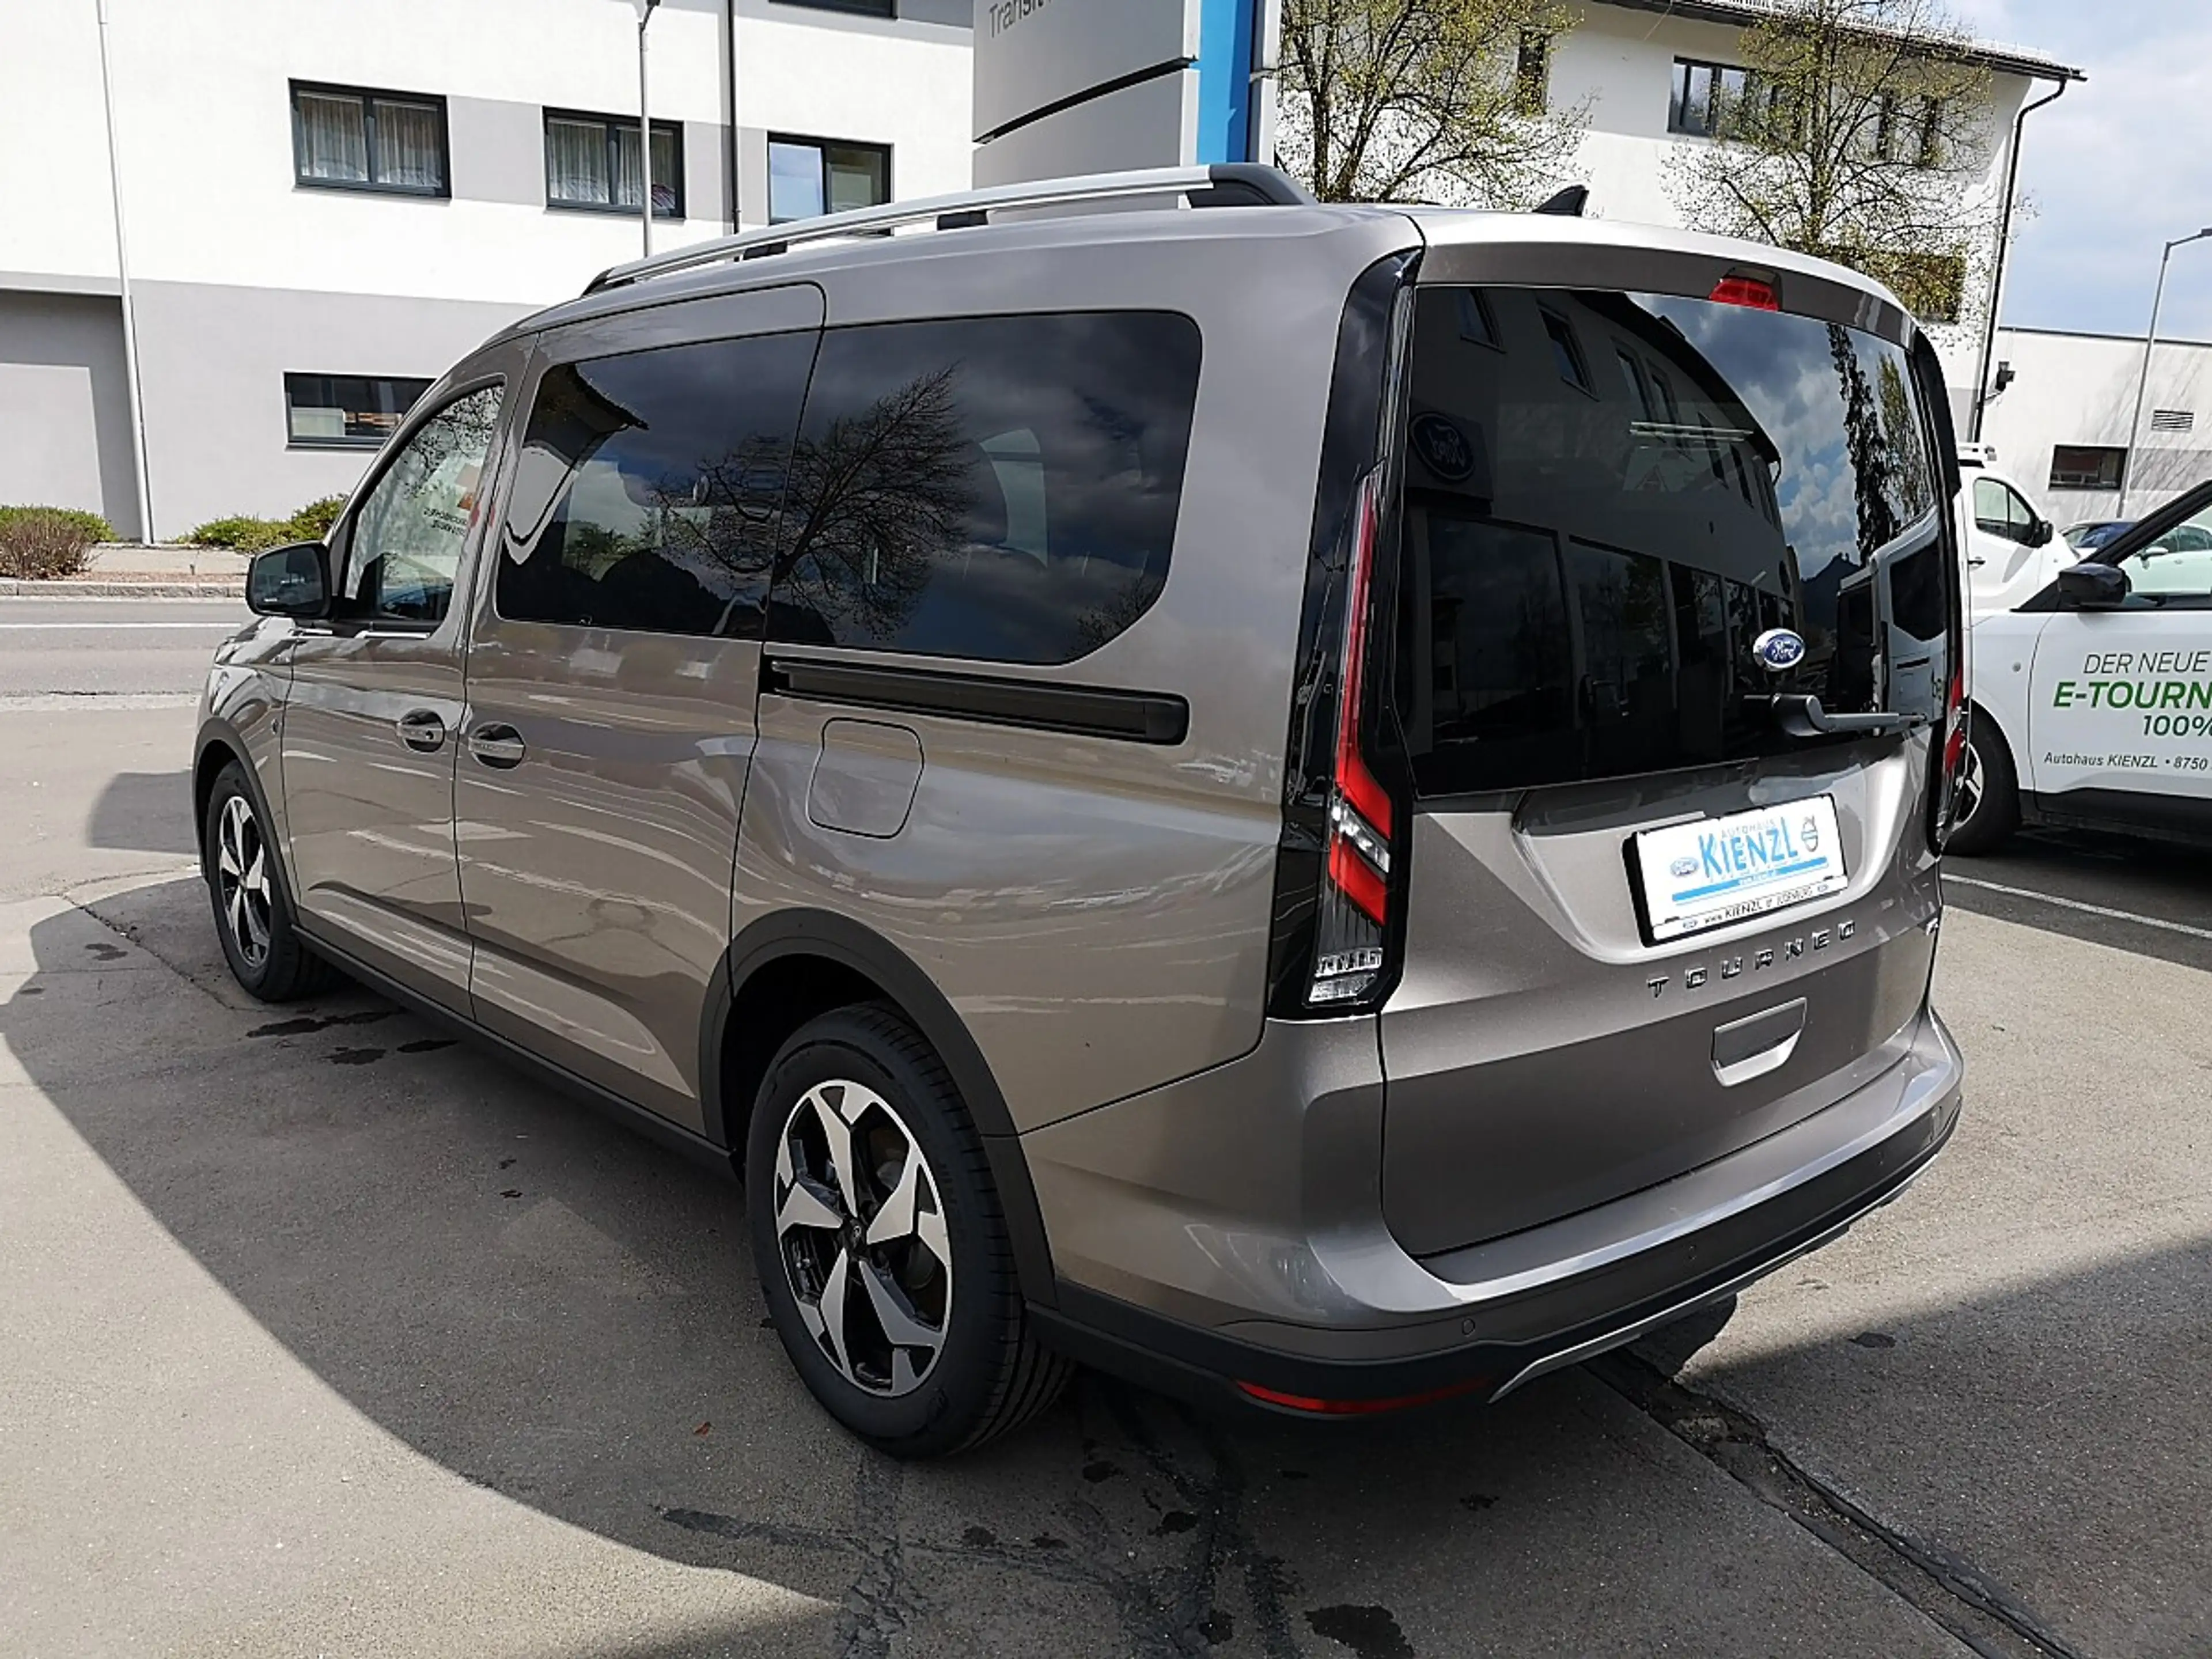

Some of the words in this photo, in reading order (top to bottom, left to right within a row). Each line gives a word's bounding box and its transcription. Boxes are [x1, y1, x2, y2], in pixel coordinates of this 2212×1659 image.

[989, 0, 1044, 38] Trans
[2084, 654, 2134, 674] DER
[2138, 651, 2211, 673] NEUE
[2054, 681, 2212, 710] E-TOURN
[2044, 752, 2103, 766] Autohaus
[2107, 755, 2158, 768] KIENZL
[2173, 756, 2209, 771] 8750
[1699, 816, 1798, 878] KIENZL
[1647, 920, 1855, 998] TOURNEO
